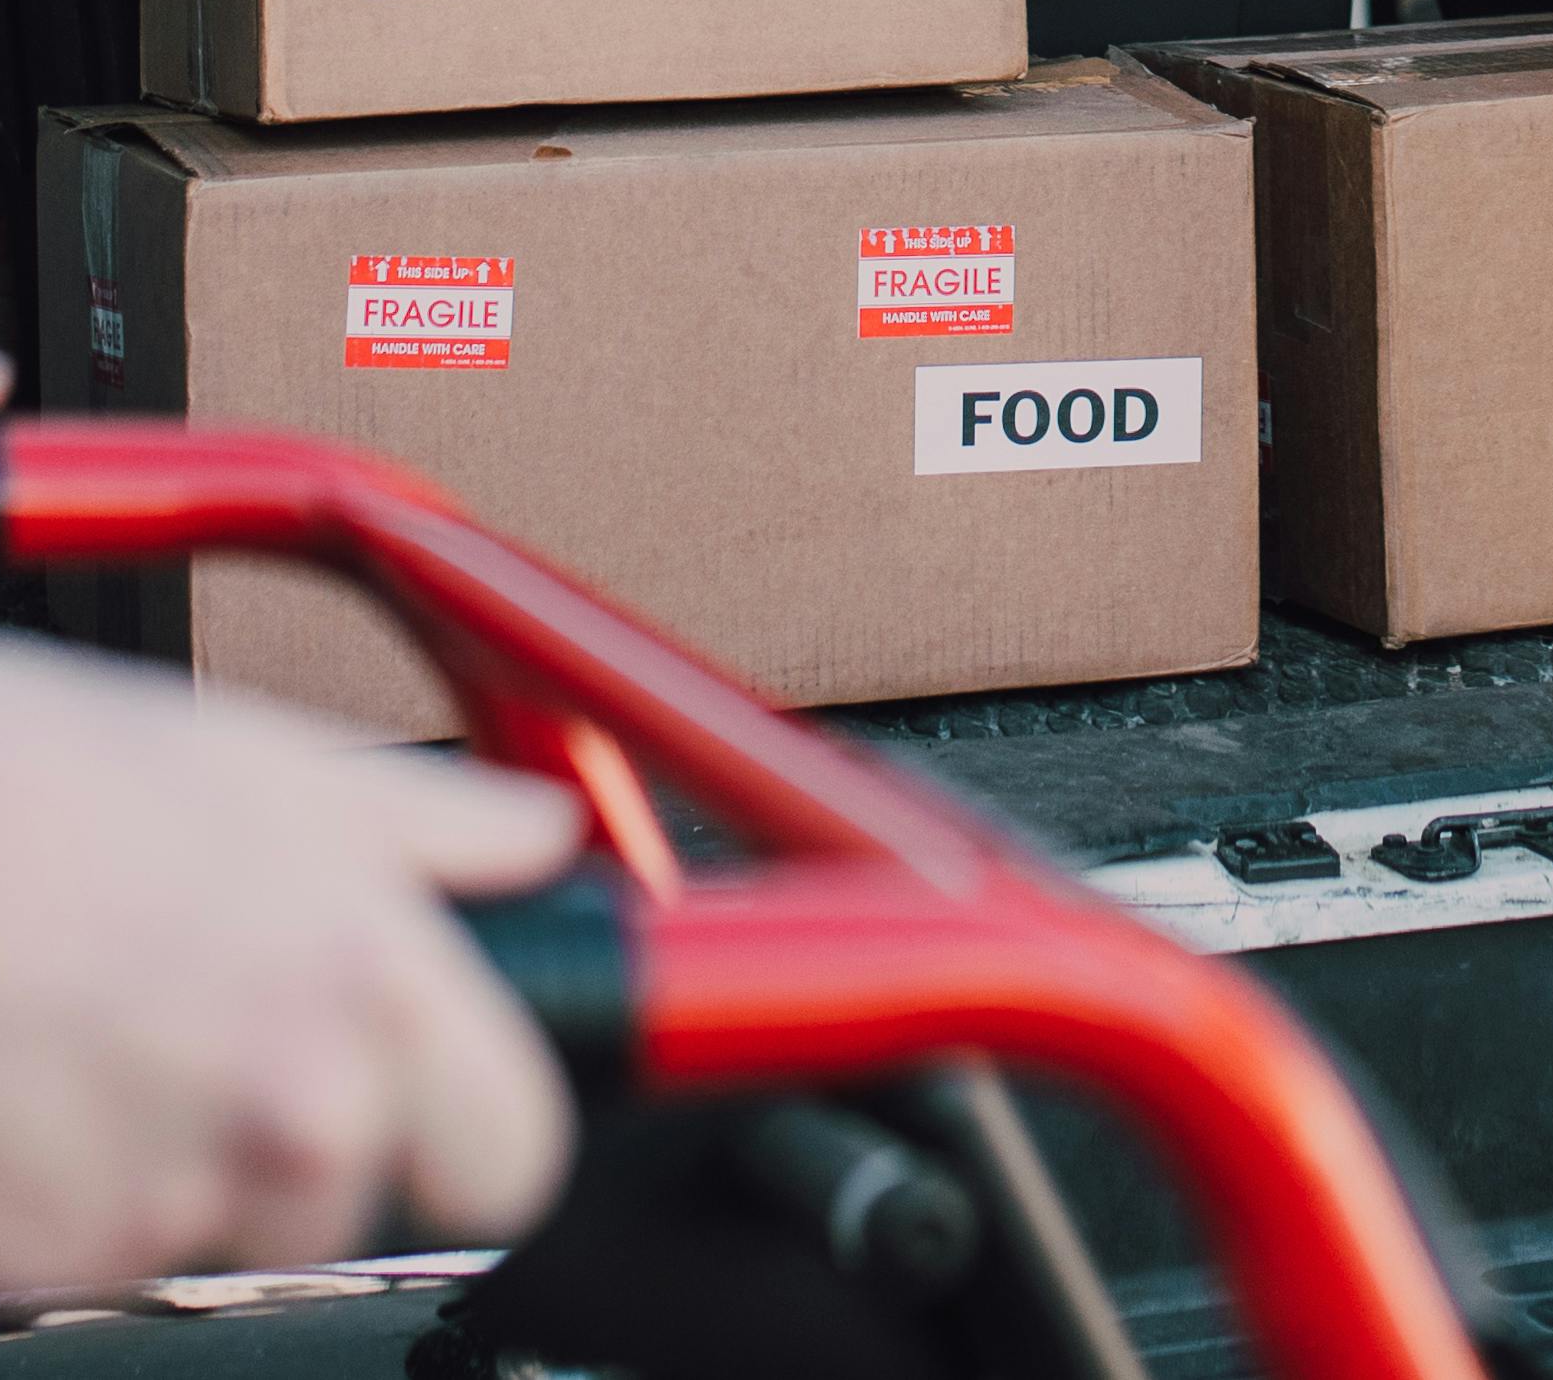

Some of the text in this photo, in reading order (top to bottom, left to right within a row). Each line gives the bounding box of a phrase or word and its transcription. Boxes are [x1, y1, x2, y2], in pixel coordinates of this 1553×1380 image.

[904, 236, 972, 249] THIS SIDE UP
[397, 266, 469, 279] THIS SIDE UP
[874, 268, 1001, 297] FRAGILE
[363, 299, 498, 328] FRAGILE
[882, 309, 991, 324] HANDLE WITH CARE
[371, 342, 486, 355] HANDLE WITH CARE
[962, 387, 1159, 446] FOOD
